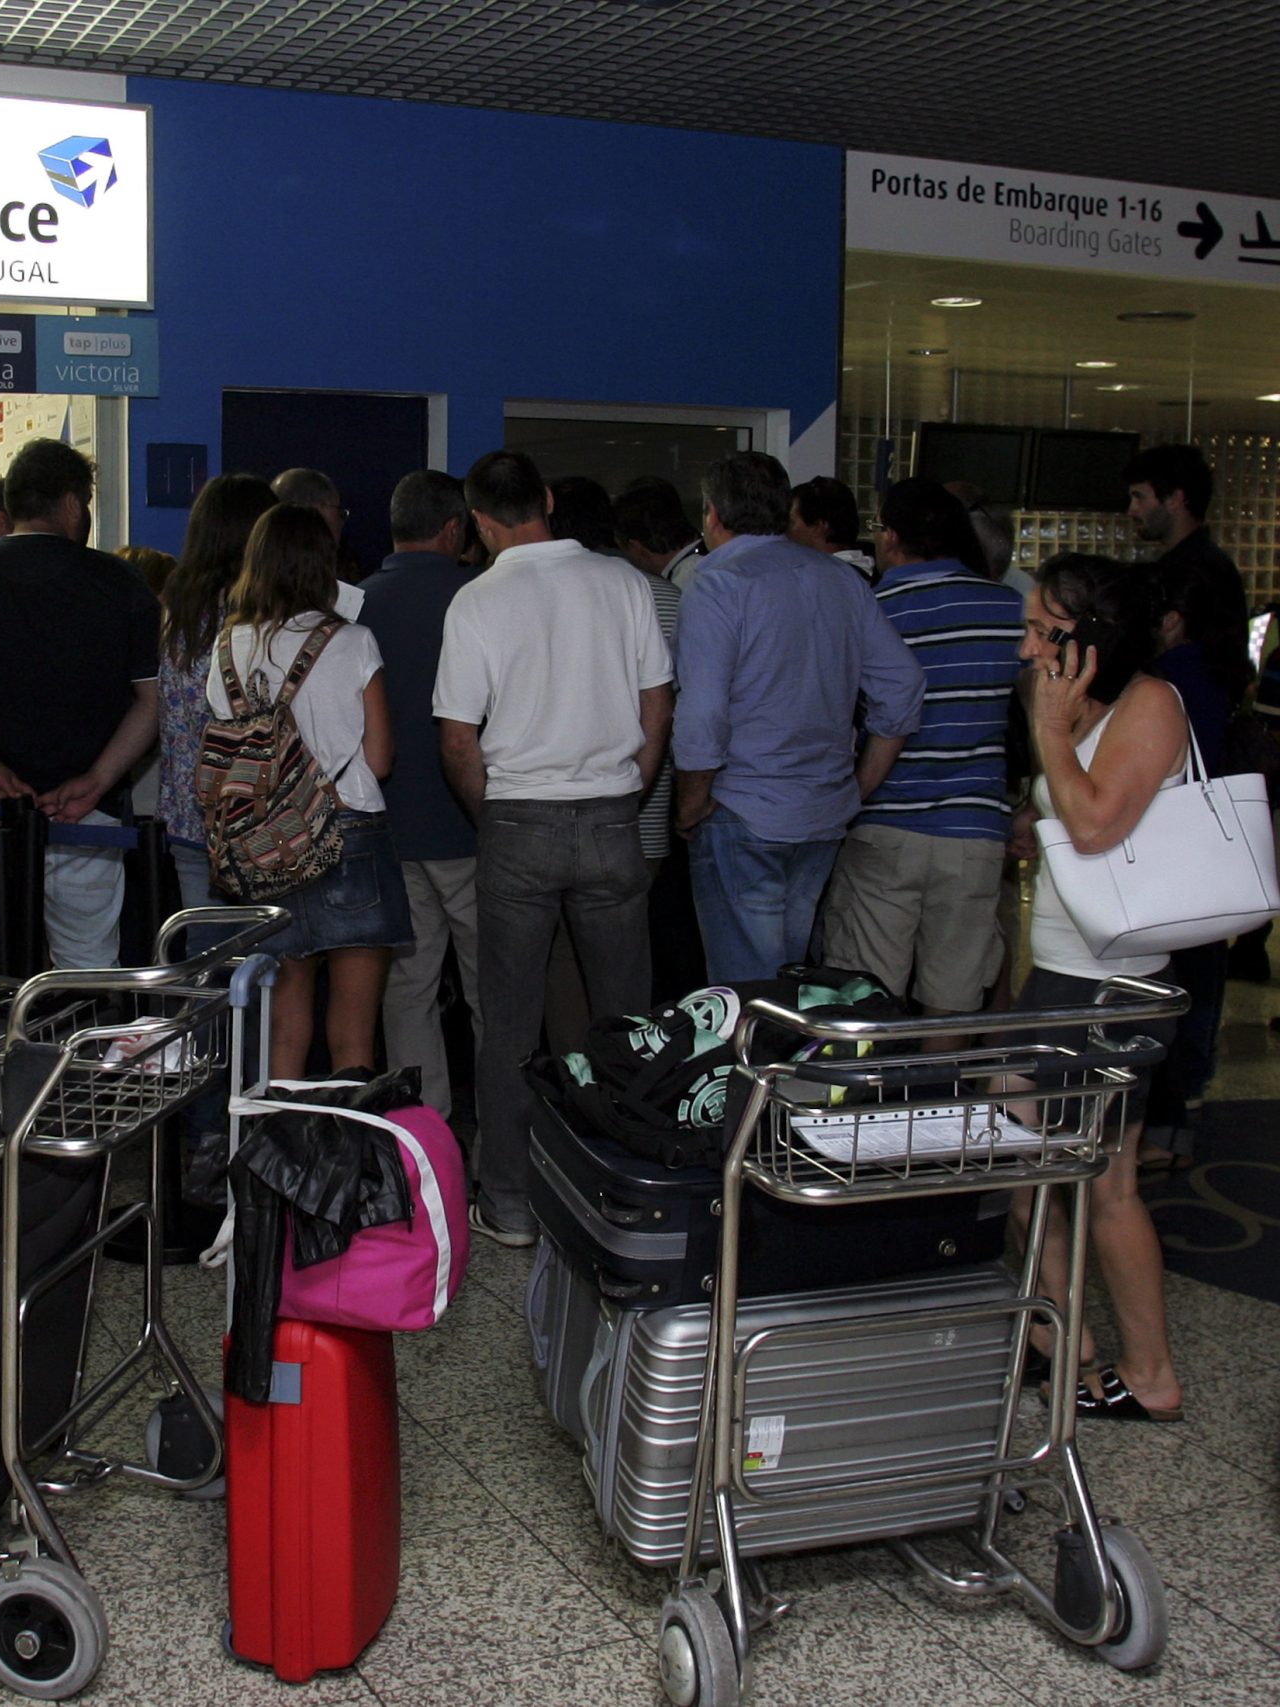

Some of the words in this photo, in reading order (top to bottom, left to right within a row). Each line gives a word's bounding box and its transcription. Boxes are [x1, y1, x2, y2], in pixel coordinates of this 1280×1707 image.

[871, 168, 948, 200] Portas
[956, 175, 986, 204] de
[993, 181, 1109, 220] Embarque
[1117, 195, 1163, 222] 1-16
[1009, 218, 1100, 257] Boarding
[1107, 228, 1163, 256] Gates
[68, 337, 92, 351] tap
[100, 337, 127, 352] plus
[55, 360, 140, 384] victoria
[112, 383, 140, 393] SILVER
